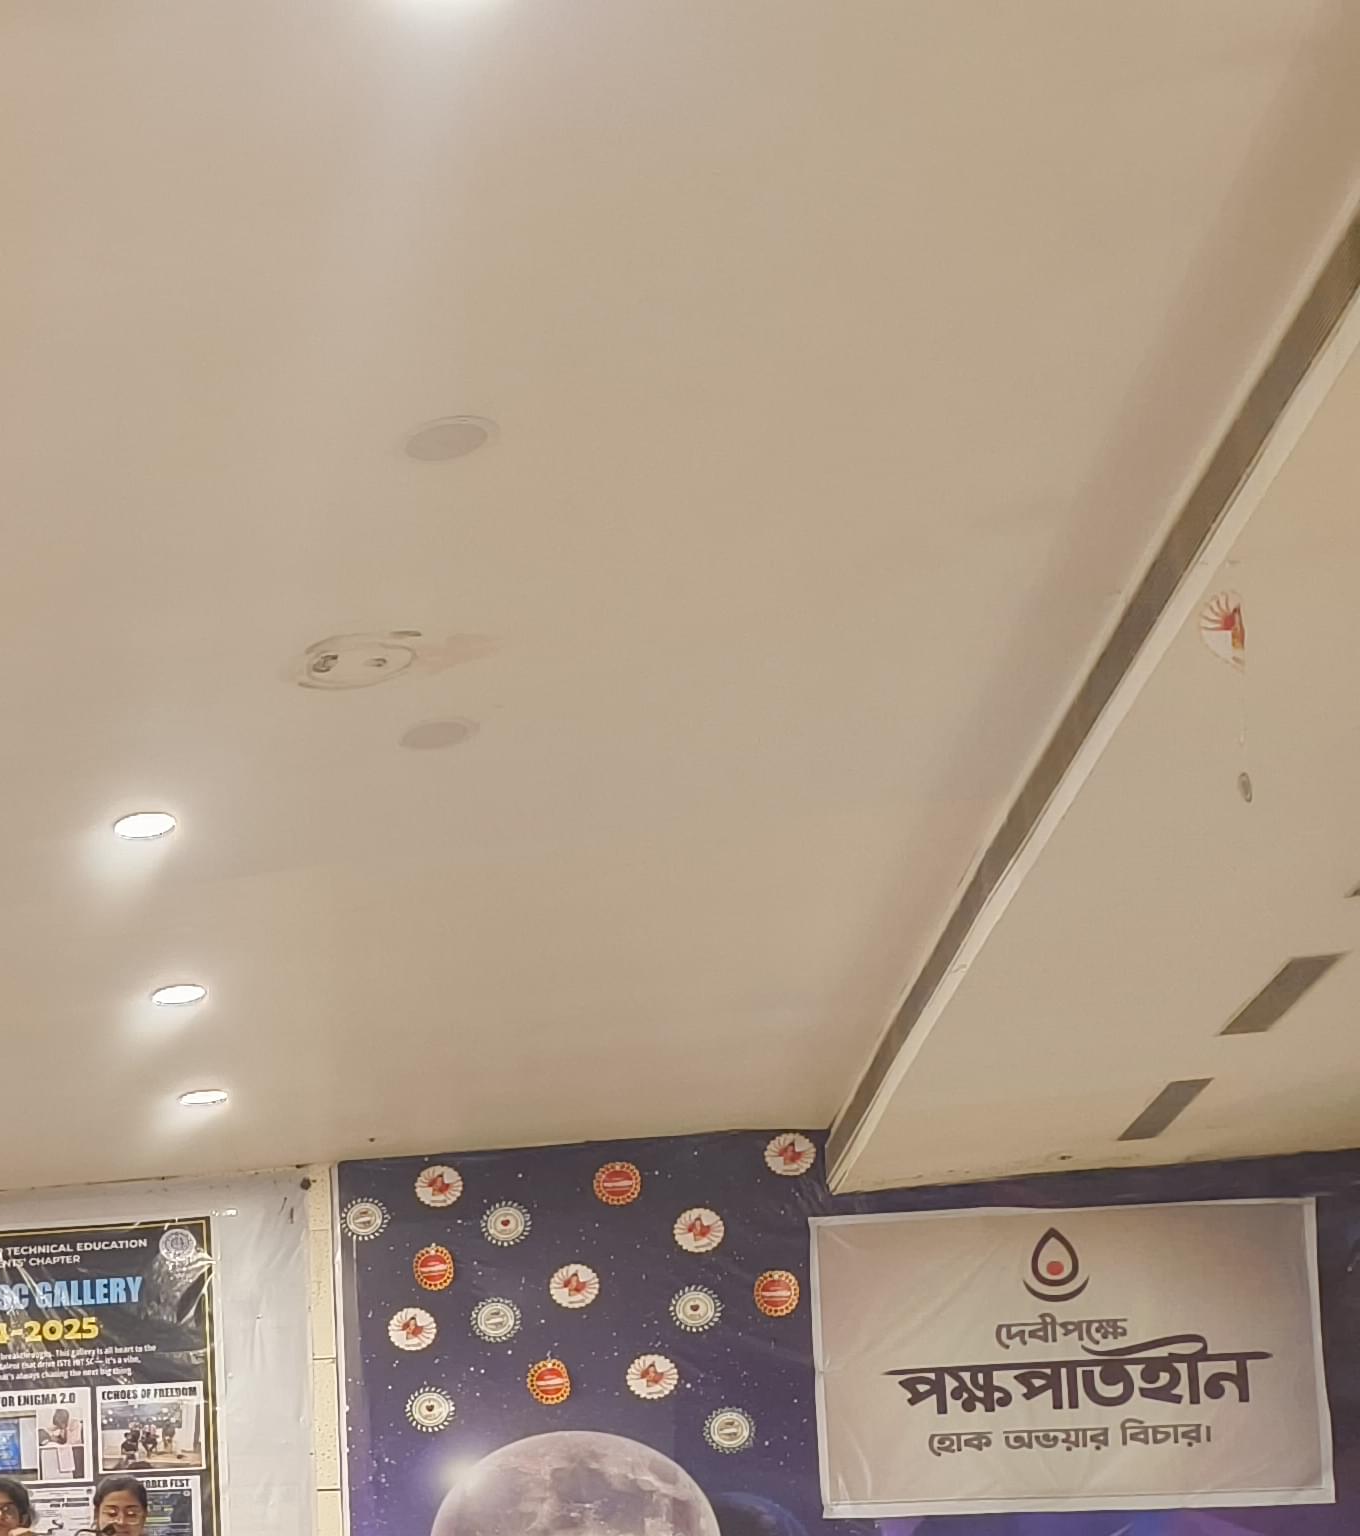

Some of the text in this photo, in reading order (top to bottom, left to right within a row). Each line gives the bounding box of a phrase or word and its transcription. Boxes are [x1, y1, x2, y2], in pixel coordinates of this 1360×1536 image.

[7, 1242, 74, 1257] TECHNICAL
[77, 1238, 148, 1252] EDUCATION
[30, 1254, 80, 1266] CHAPTER
[37, 1276, 143, 1309] GALLERY
[994, 1313, 1128, 1349] দেবীপক্ষে
[144, 1344, 156, 1352] the
[883, 1334, 1273, 1415] পক্ষপাতহীন
[18, 1394, 56, 1407] ENIGMA
[59, 1392, 76, 1404] 2.0
[140, 1388, 151, 1399] OF
[928, 1418, 1212, 1457] হোক অভয়ার বিচার।
